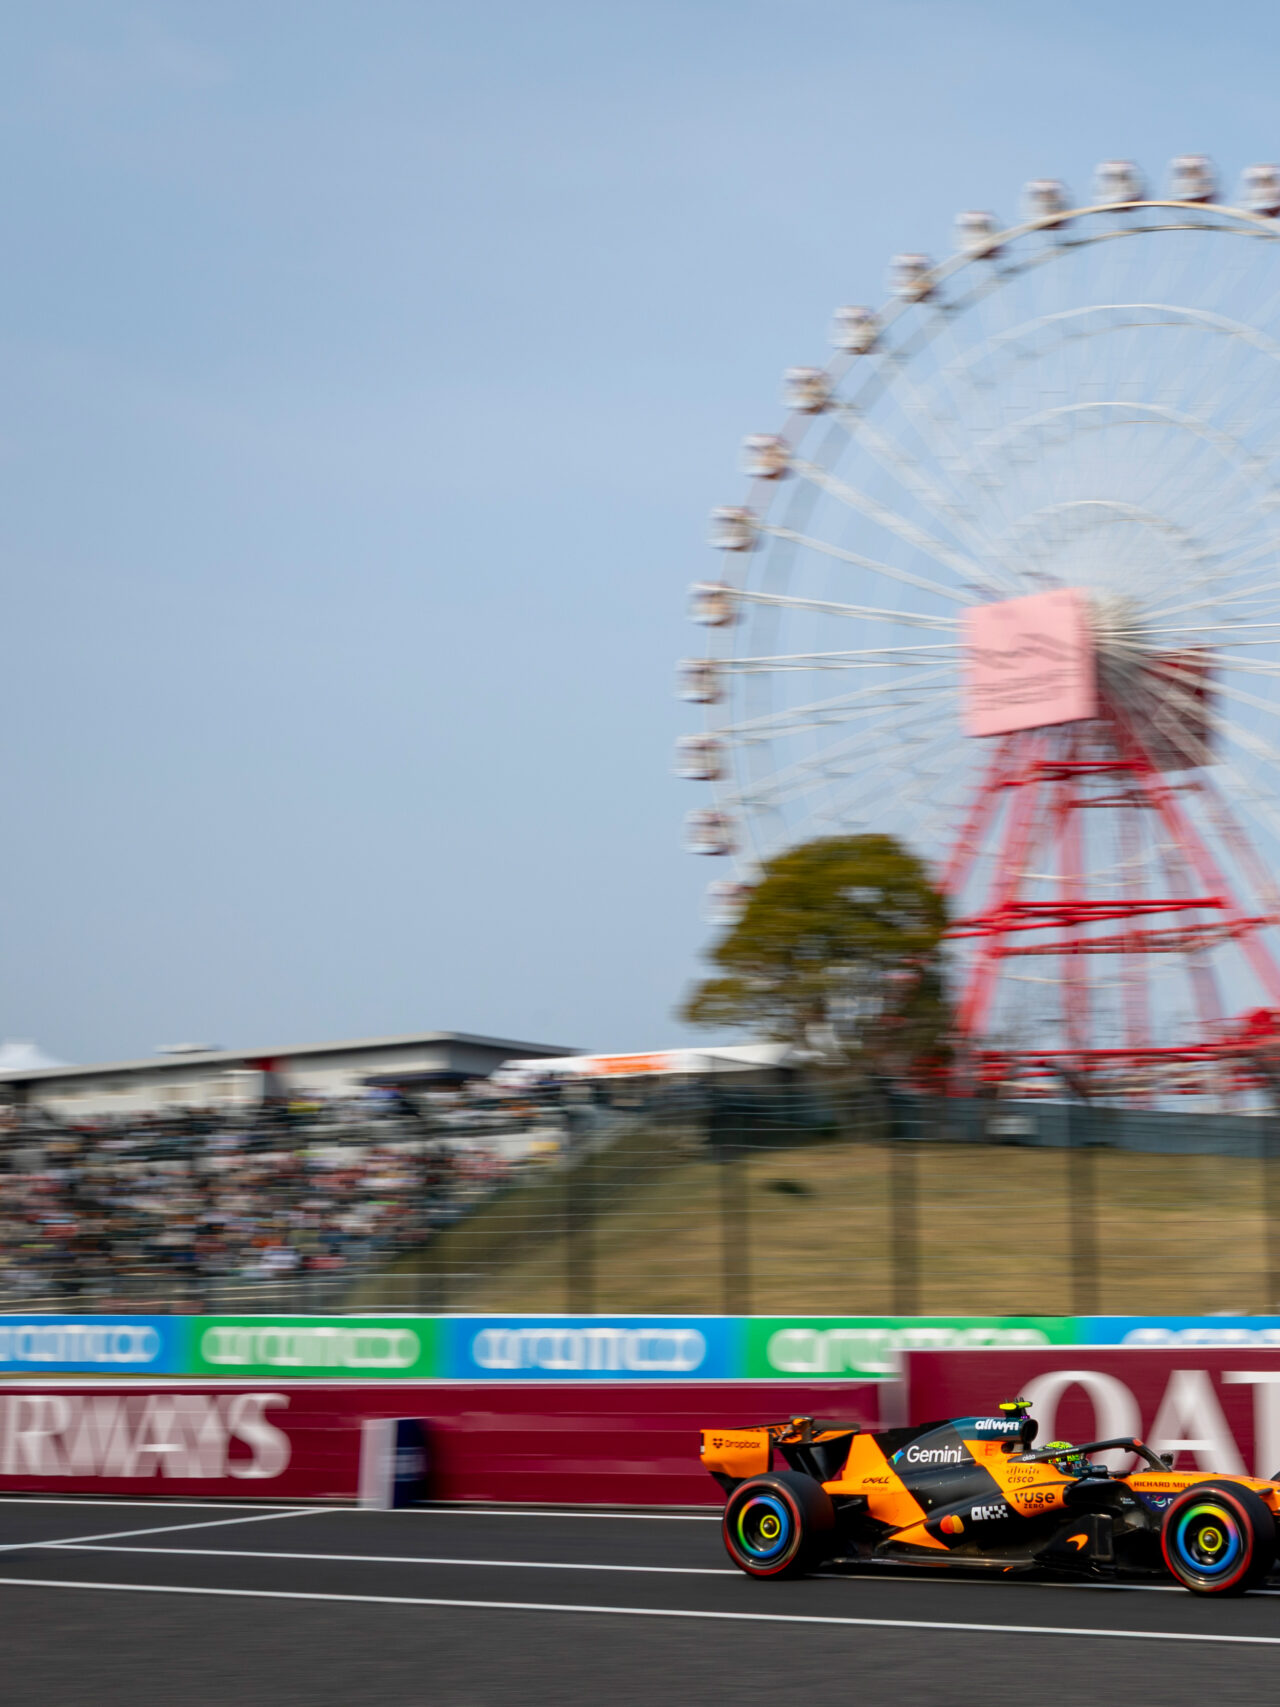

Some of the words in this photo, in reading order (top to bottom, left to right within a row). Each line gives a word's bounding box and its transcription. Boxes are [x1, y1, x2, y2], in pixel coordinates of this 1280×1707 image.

[202, 1326, 422, 1368] aramco
[472, 1328, 706, 1371] aramco
[974, 1419, 1020, 1433] allwyn
[0, 1393, 291, 1479] RWAYS
[725, 1439, 760, 1449] Dropbox
[906, 1445, 962, 1463] Gemini
[1172, 1481, 1192, 1489] MILL
[971, 1504, 1009, 1520] OKX
